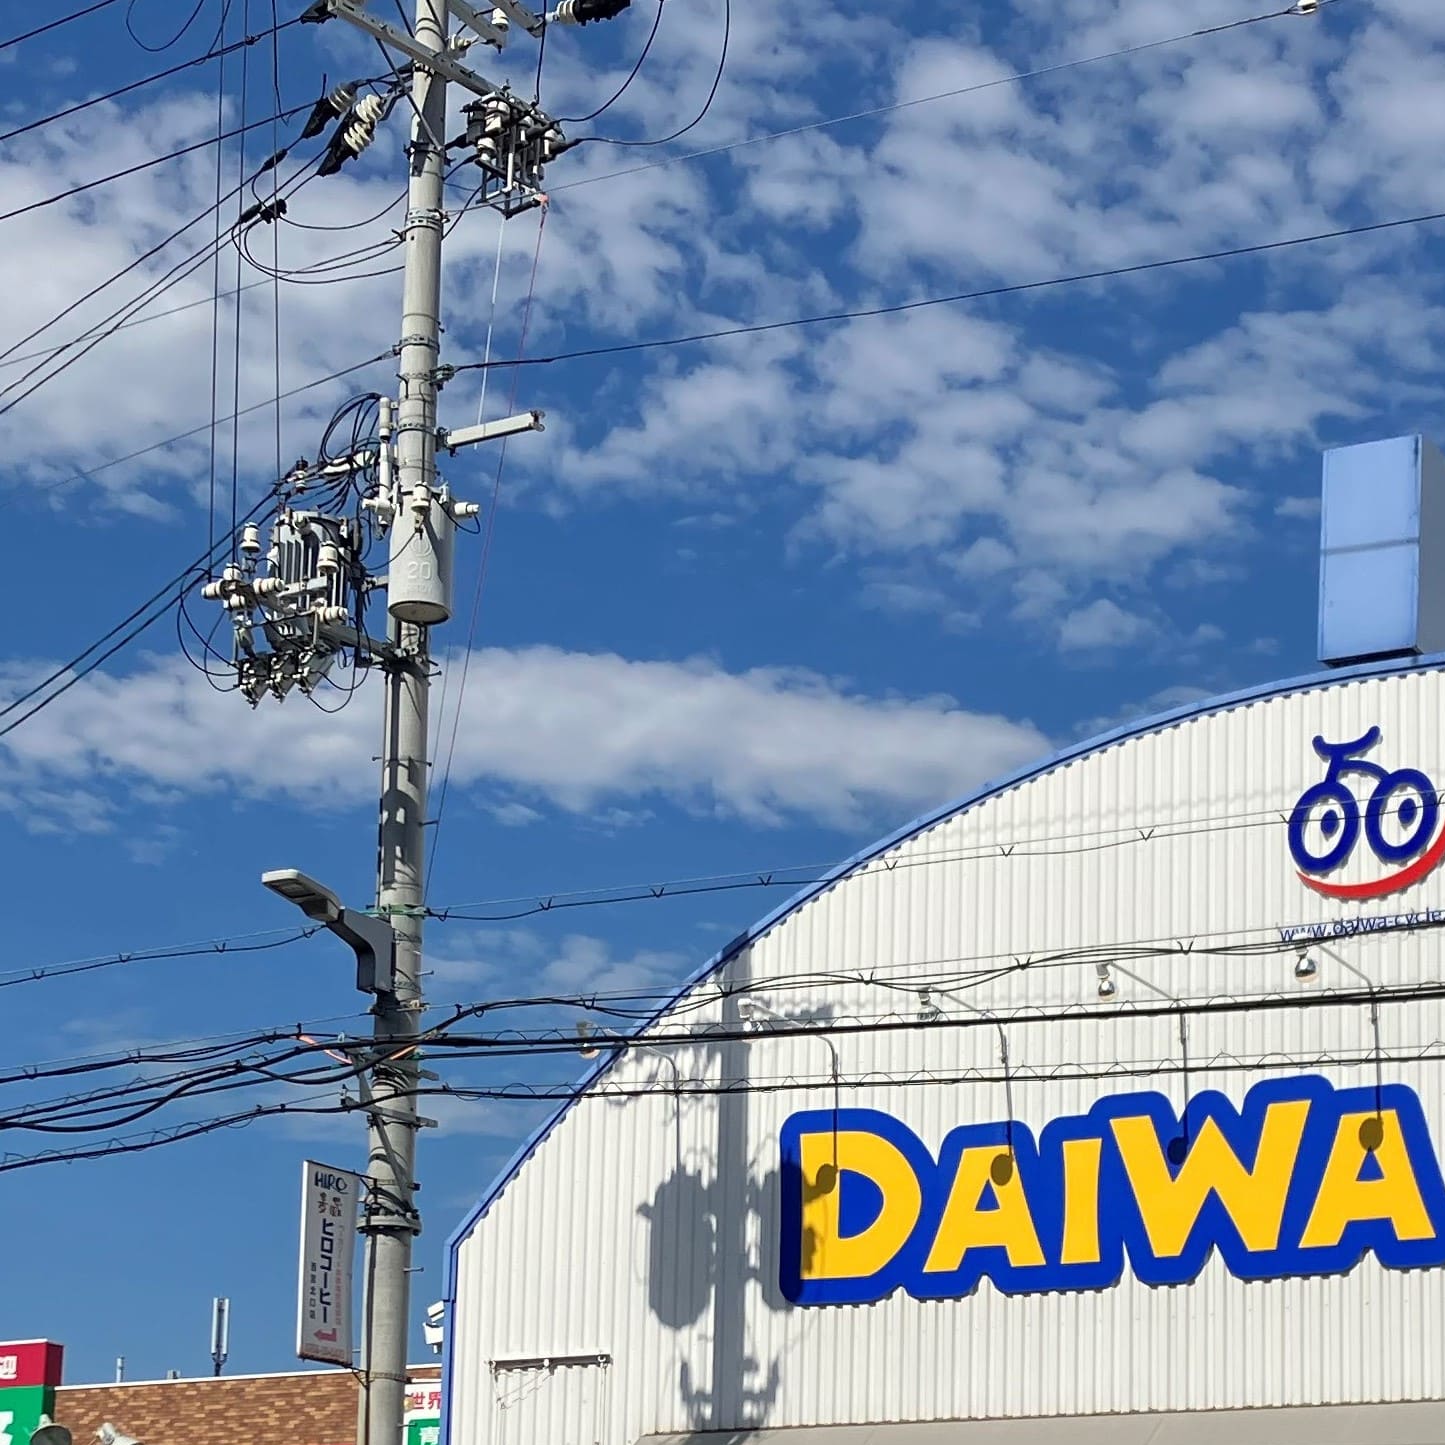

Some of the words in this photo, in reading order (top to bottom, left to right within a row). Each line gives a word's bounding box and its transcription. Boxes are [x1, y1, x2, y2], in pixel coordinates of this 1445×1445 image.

[407, 561, 432, 580] 20
[320, 1217, 335, 1324] ヒロコーヒー
